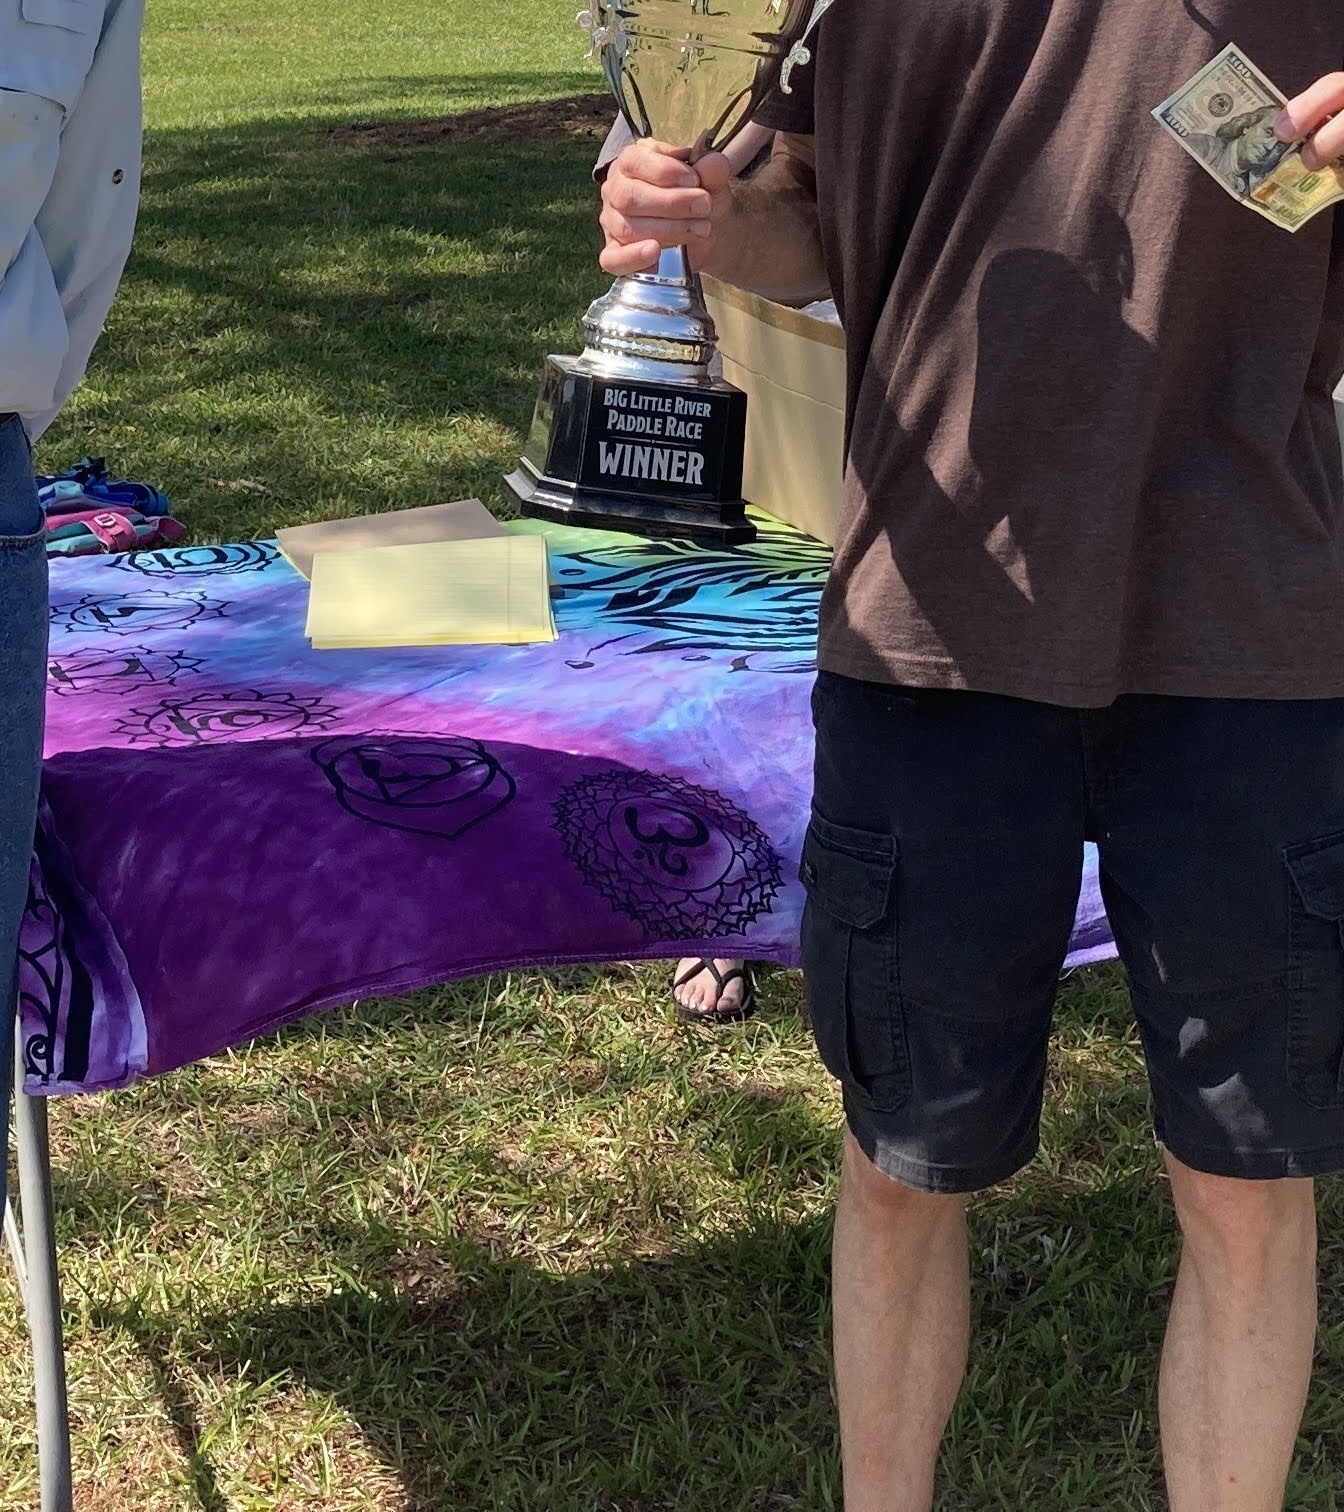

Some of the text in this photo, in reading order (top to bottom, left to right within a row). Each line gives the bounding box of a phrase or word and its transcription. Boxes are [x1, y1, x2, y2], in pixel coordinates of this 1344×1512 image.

[1229, 54, 1253, 79] 100
[1165, 112, 1189, 138] 100
[603, 388, 712, 418] BIG LITTLE RIVER
[607, 409, 703, 439] PADDLE RACE
[598, 441, 705, 486] WINNER
